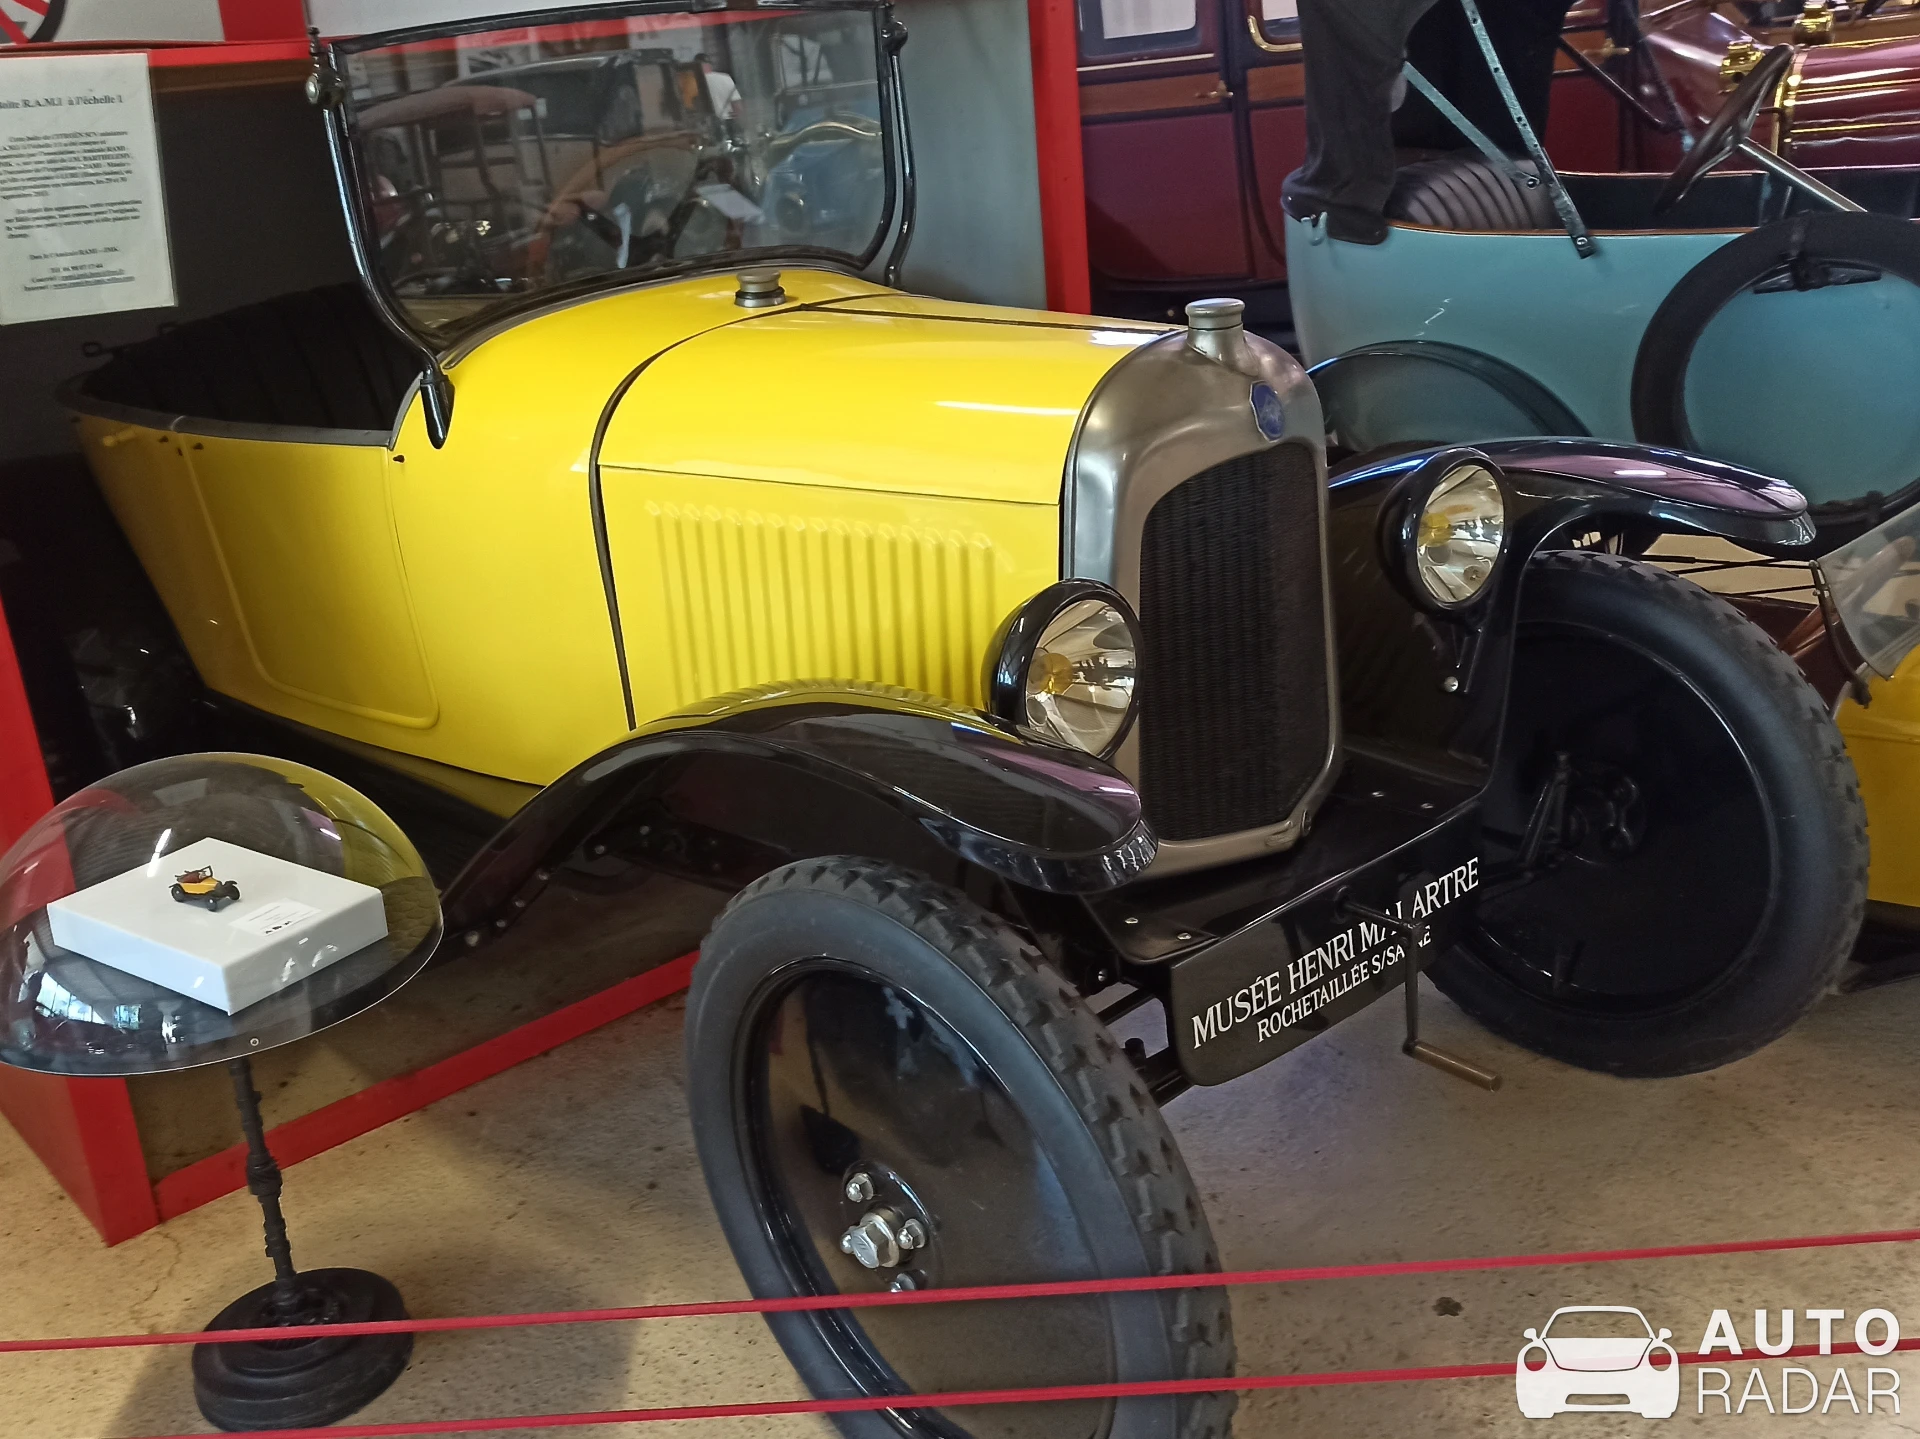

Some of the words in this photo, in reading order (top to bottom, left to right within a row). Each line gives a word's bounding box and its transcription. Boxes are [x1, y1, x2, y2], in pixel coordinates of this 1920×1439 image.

[1192, 970, 1282, 1049] MUSÉE
[1287, 929, 1356, 994] HENRI
[1257, 960, 1370, 1043] ROCHETAILLÉE
